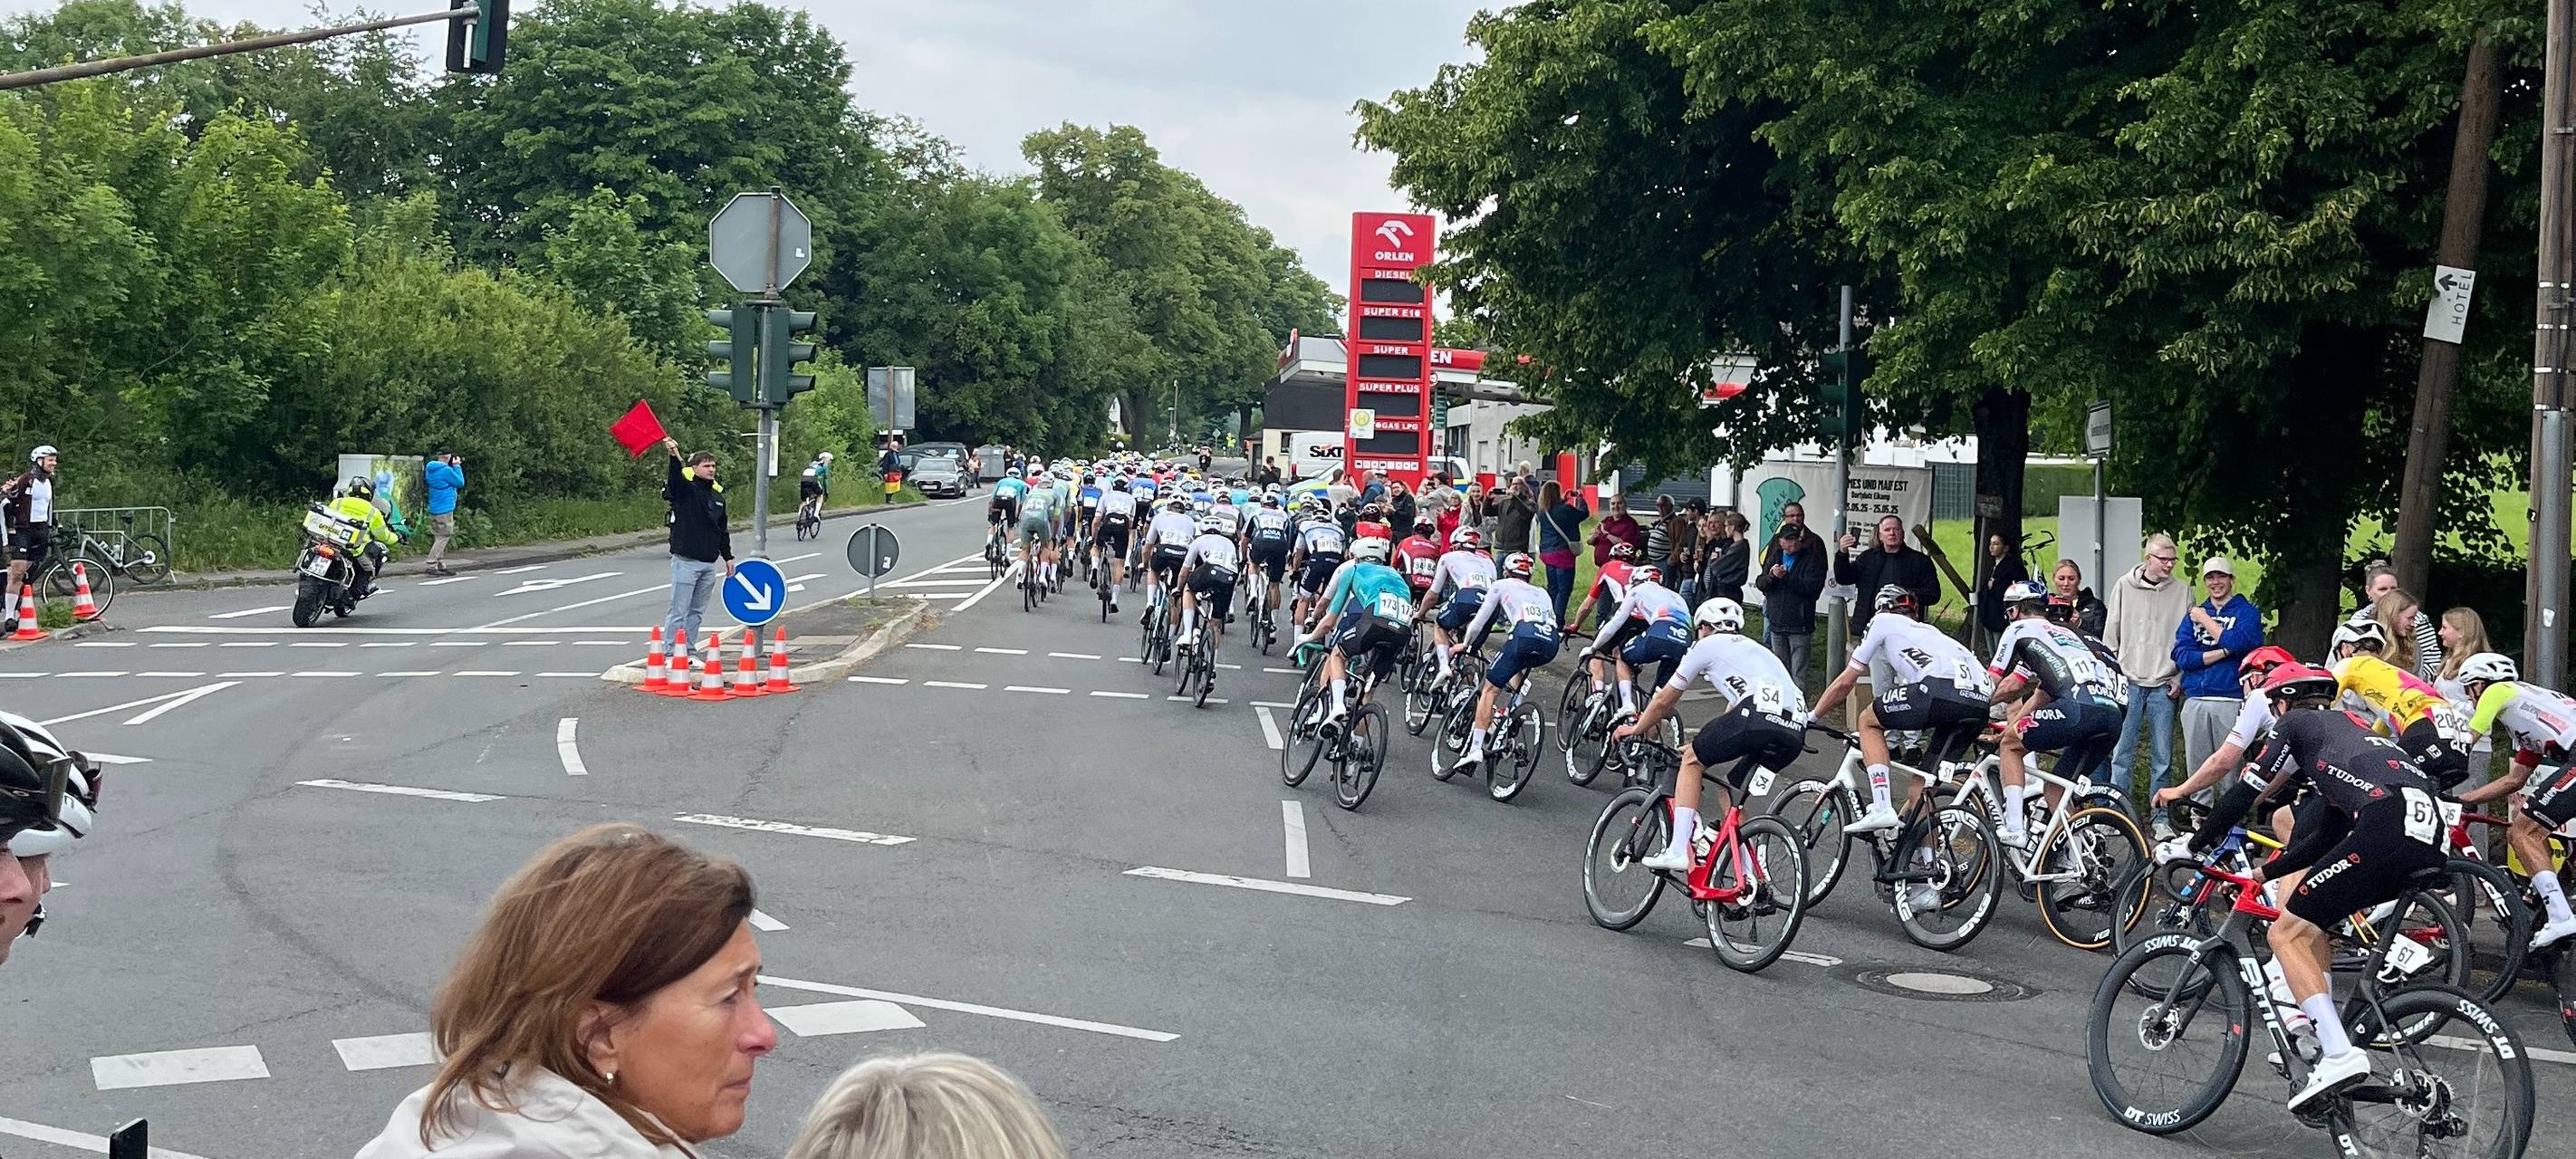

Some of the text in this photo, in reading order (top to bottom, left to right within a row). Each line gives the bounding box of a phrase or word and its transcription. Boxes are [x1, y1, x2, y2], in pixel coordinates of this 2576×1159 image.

[1375, 251, 1414, 261] ORLEN
[1375, 271, 1411, 279] DIESEL
[2451, 273, 2473, 325] HOTEL
[1363, 308, 1421, 317] SUPER E10
[1373, 346, 1408, 354] SUPER
[1359, 383, 1420, 392] SUPER PLUS
[1862, 480, 1877, 490] UND
[1873, 504, 1898, 513] 25.05.25
[1382, 599, 1397, 610] 173
[1525, 606, 1541, 617] 103
[1901, 647, 1933, 669] KTM
[1996, 644, 2007, 663] BORA
[2075, 660, 2090, 674] 11
[1725, 675, 1747, 697] KTM
[2087, 685, 2115, 699] BORA
[1882, 687, 1908, 704] UAE
[1764, 714, 1802, 732] GERMANY
[2034, 708, 2066, 720] BORA
[2270, 743, 2291, 772] TUDOR
[2327, 764, 2374, 792] TUDOR
[2307, 858, 2352, 889] TUDOR
[2145, 934, 2202, 953] DT SWISS
[2397, 946, 2415, 965] 67
[2238, 957, 2292, 1051] BMC
[2456, 999, 2516, 1059] DT SWISS
[2124, 1106, 2181, 1126] DT SWISS
[2338, 1134, 2359, 1156] DT
